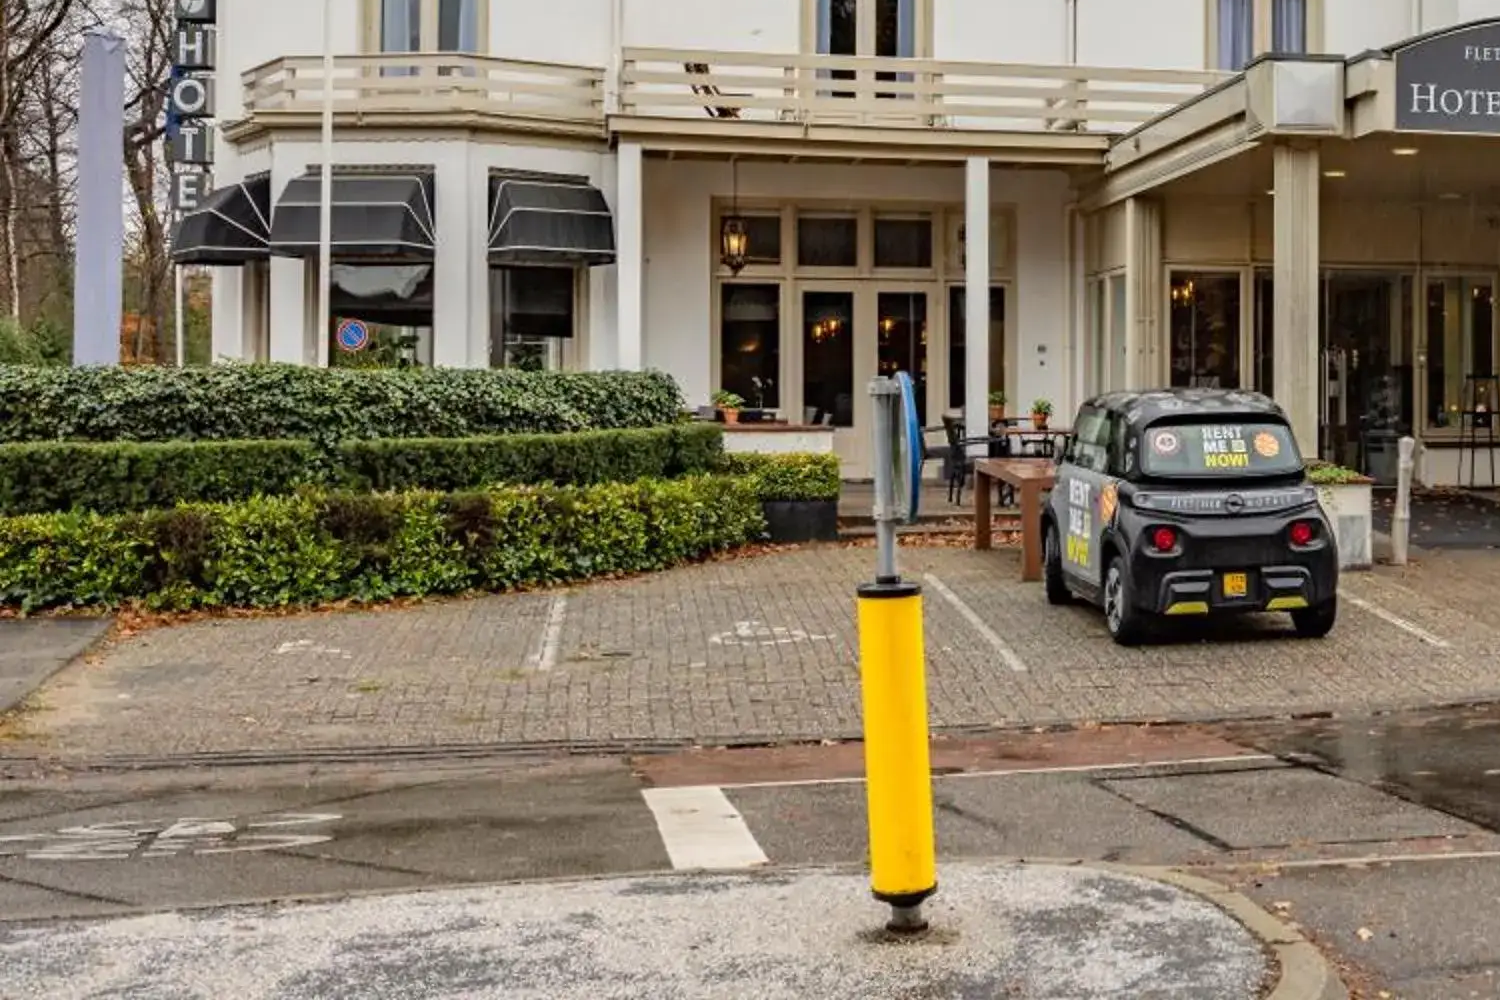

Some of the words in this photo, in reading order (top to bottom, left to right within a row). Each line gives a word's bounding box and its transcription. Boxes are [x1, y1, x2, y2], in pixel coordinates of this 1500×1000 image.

[173, 31, 206, 208] HOTE
[1201, 424, 1242, 439] RENT
[1203, 439, 1228, 453] ME
